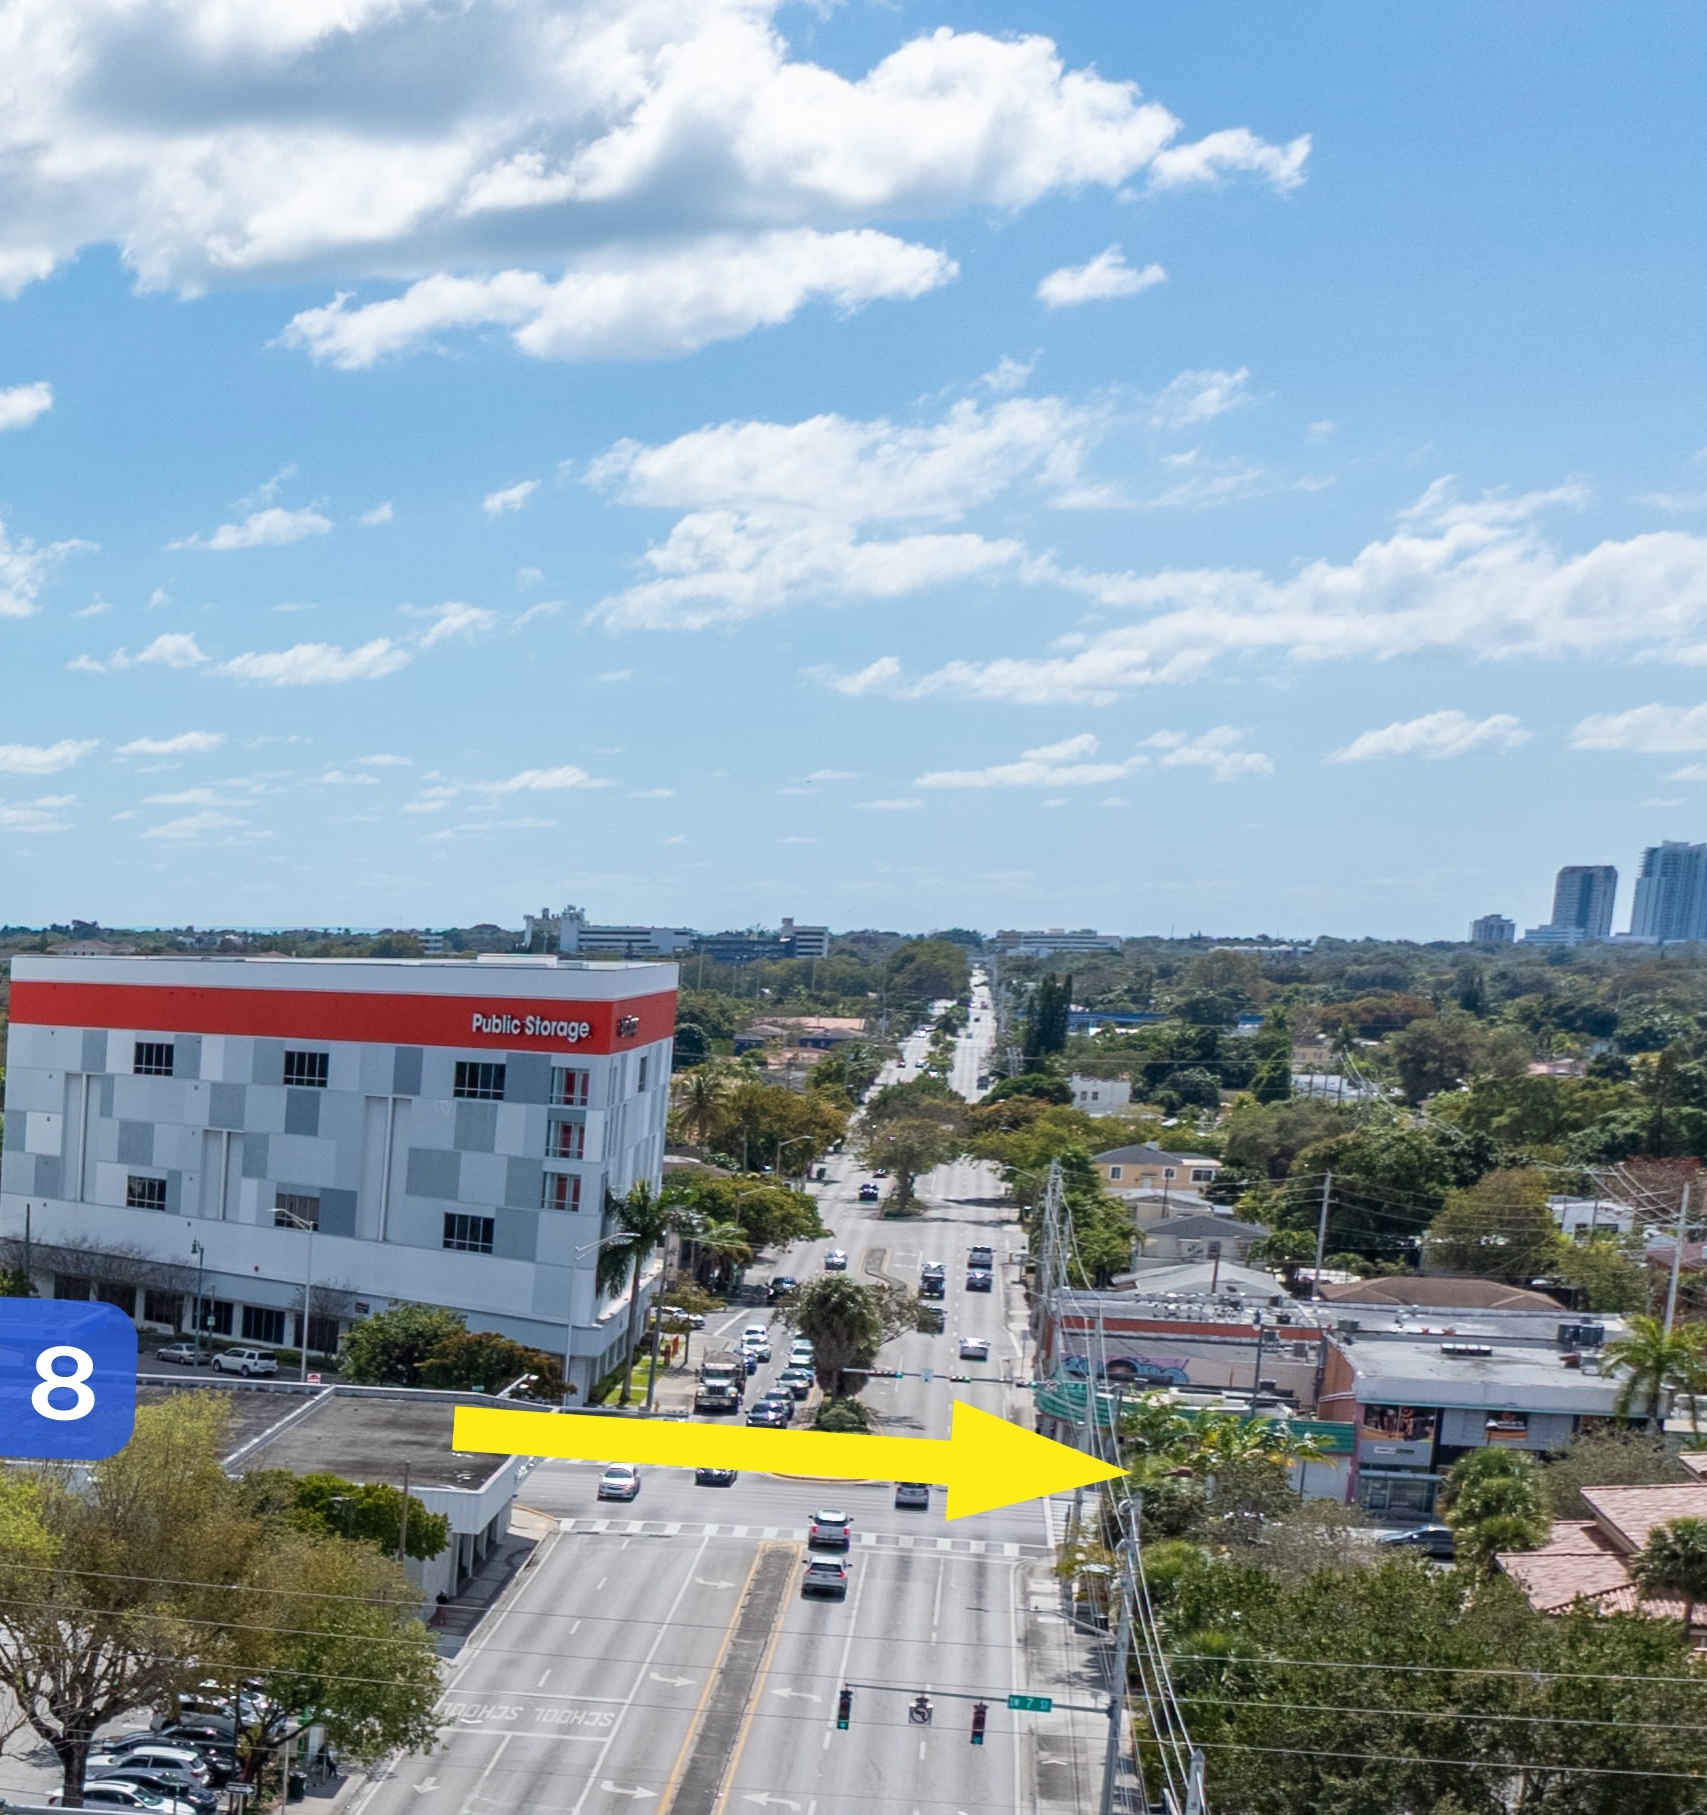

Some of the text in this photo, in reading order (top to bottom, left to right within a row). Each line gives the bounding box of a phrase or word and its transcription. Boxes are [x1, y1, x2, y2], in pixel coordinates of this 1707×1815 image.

[472, 1013, 521, 1035] Public
[524, 1015, 590, 1043] Storage
[1027, 1697, 1035, 1709] 7
[533, 1708, 615, 1727] SCHOOL
